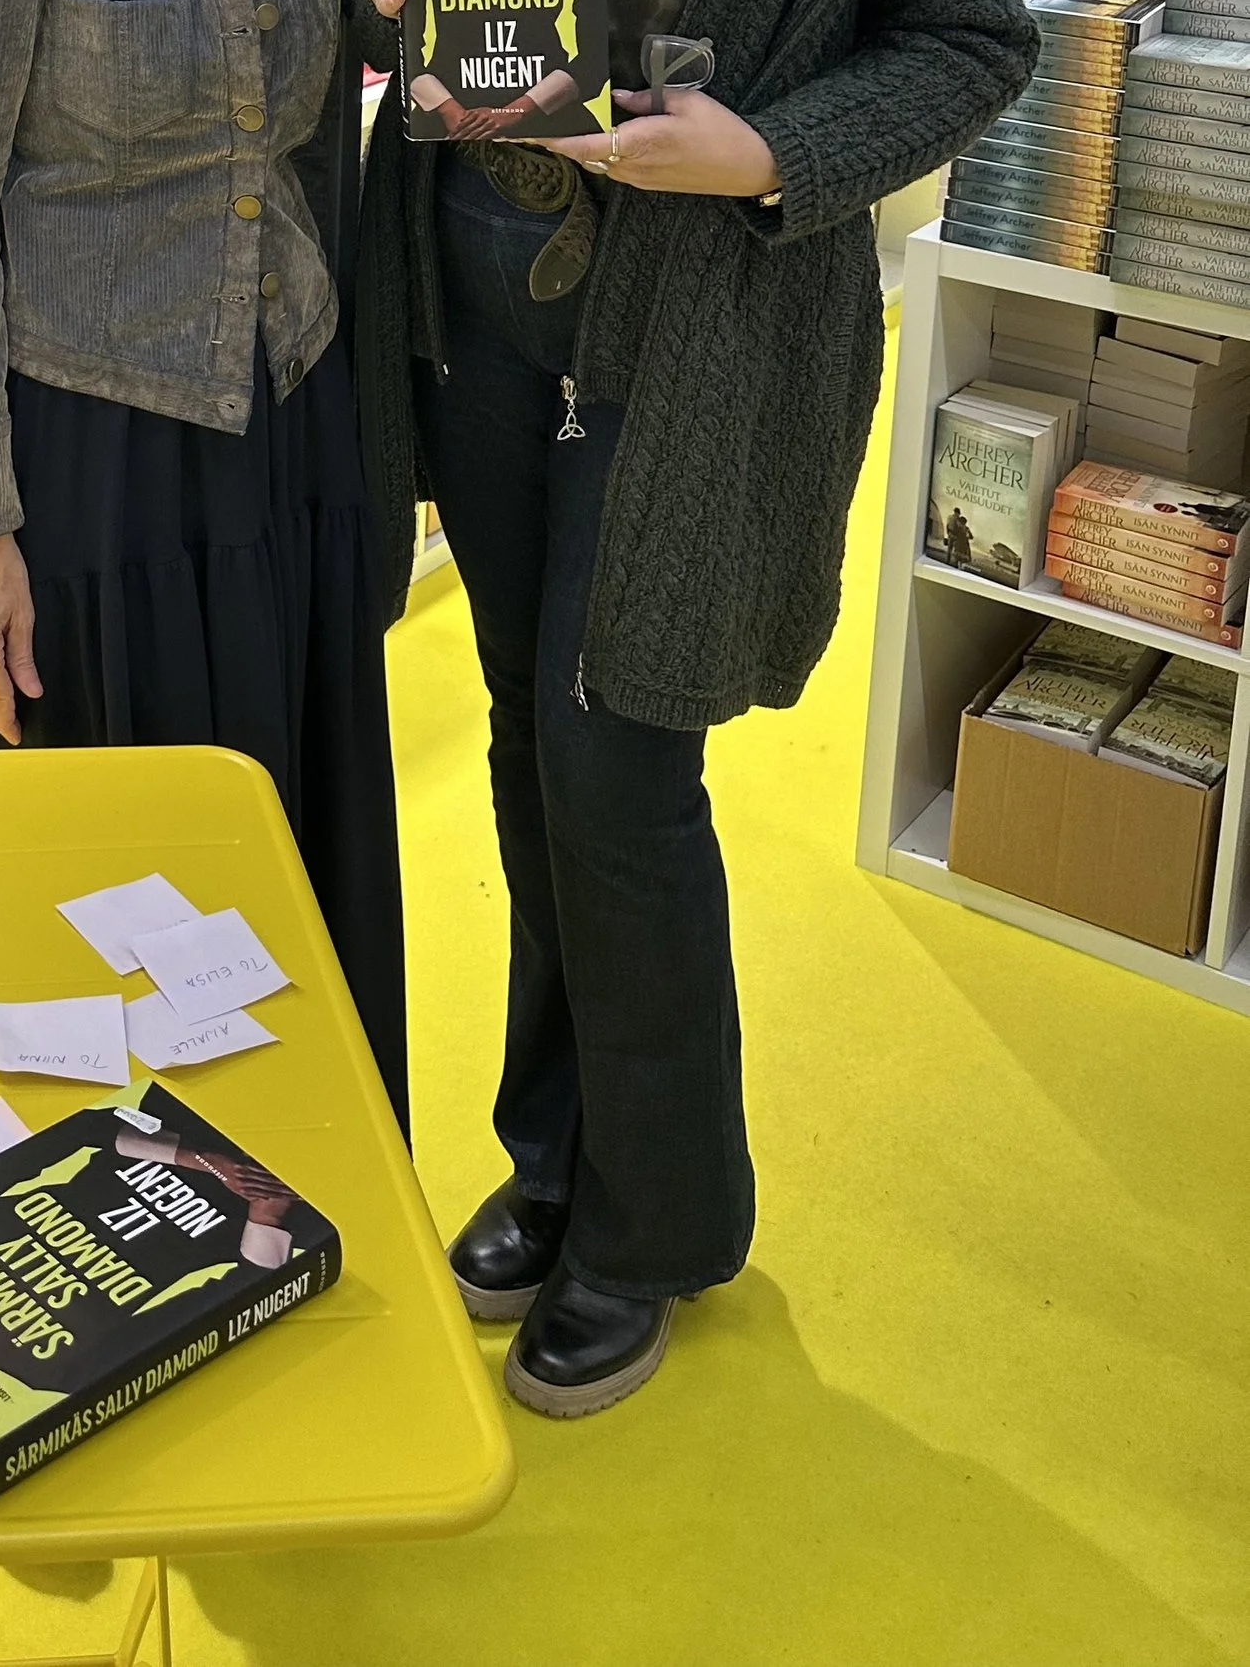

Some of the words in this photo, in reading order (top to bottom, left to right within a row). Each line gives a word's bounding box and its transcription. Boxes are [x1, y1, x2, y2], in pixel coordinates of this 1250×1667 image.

[485, 21, 518, 52] LIZ
[460, 56, 544, 89] NUGENT
[952, 432, 1015, 466] JEFFREY
[939, 442, 1023, 490] ARCHER
[946, 486, 1013, 516] SALAISUUDET
[959, 479, 1001, 501] VAIETUT
[1161, 524, 1199, 541] SYNNIT
[1150, 568, 1190, 587] SYNNIT
[185, 966, 233, 988] ELISA
[115, 1161, 227, 1238] NUGENT
[98, 1197, 160, 1241] LIZ
[14, 1192, 152, 1306] DIAMOND
[5, 1408, 92, 1482] SÄRMIKÄS
[96, 1380, 142, 1424] SALLY
[145, 1330, 219, 1394] DIAMOND
[228, 1313, 250, 1341] LIZ
[253, 1271, 310, 1327] NUGENT
